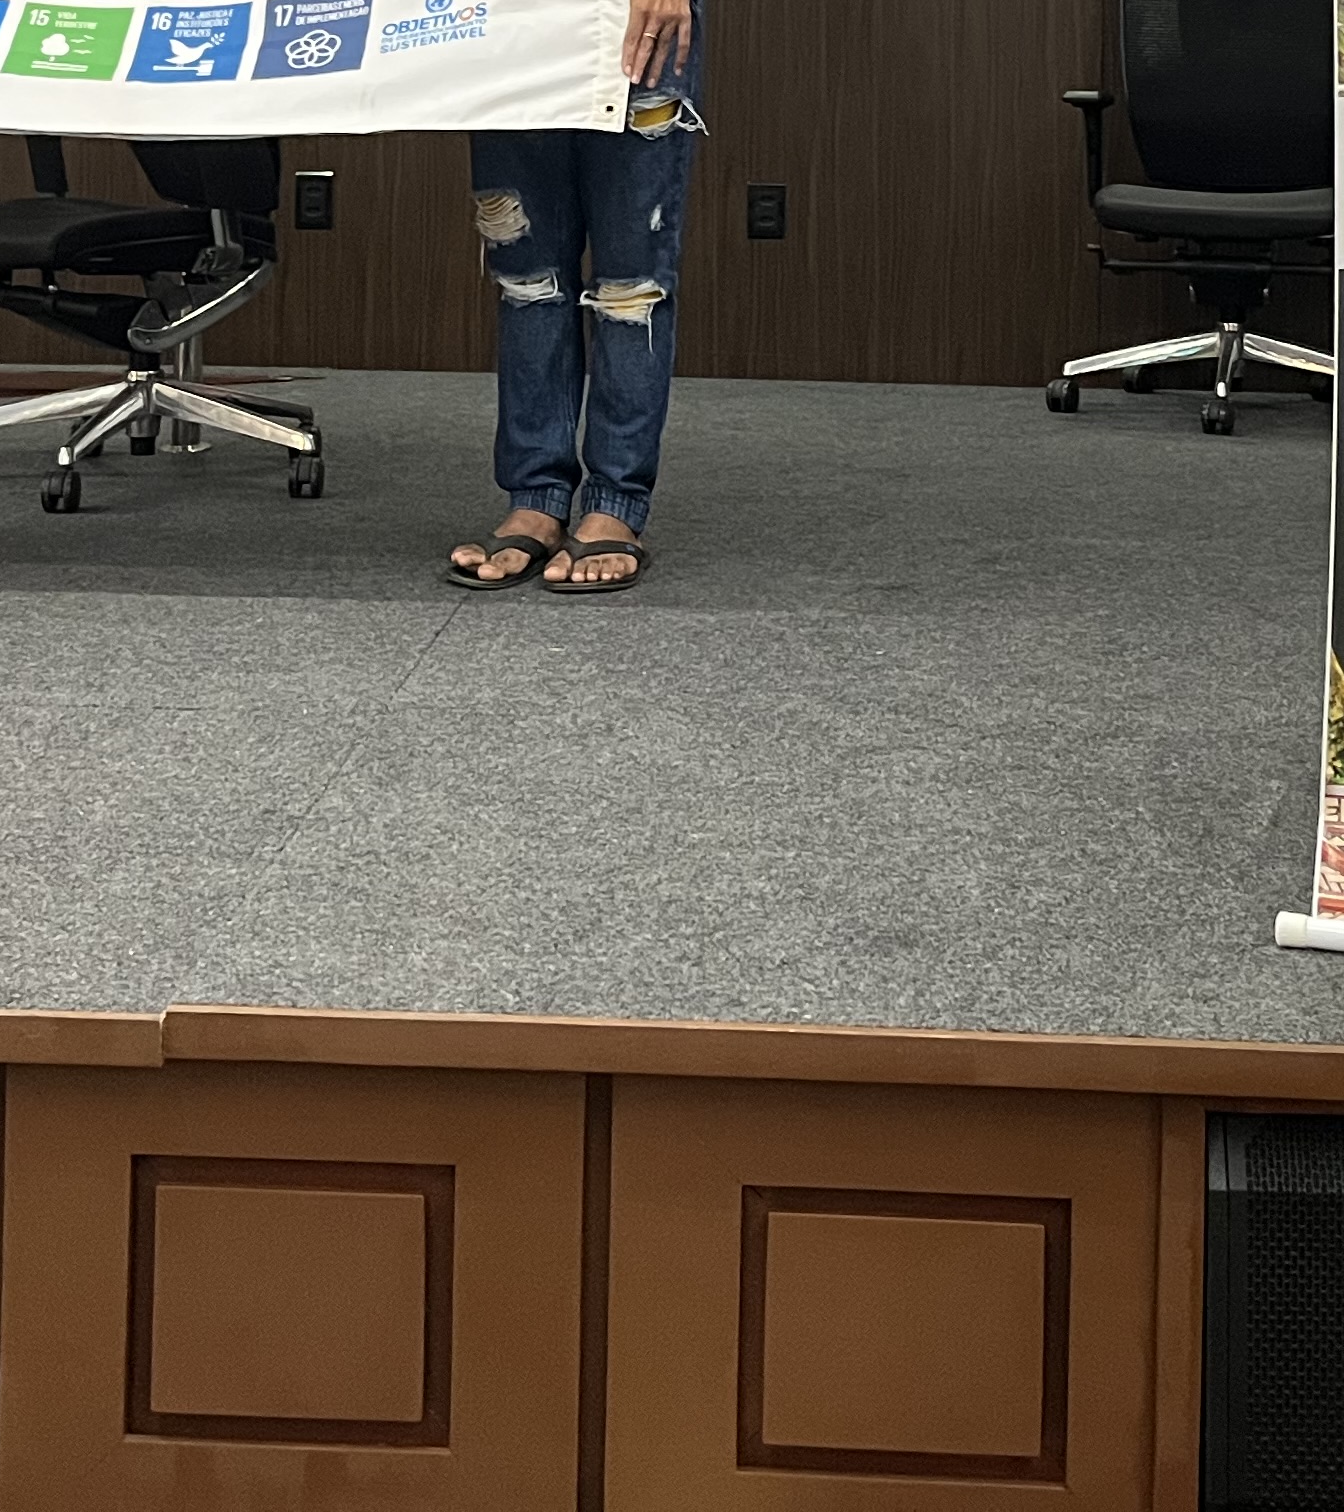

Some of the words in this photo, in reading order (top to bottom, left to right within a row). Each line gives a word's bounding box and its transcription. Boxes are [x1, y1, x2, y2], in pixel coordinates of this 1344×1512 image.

[29, 8, 51, 27] 15
[150, 11, 173, 31] 16
[273, 4, 294, 27] 17
[382, 1, 488, 36] OBJETIVOS
